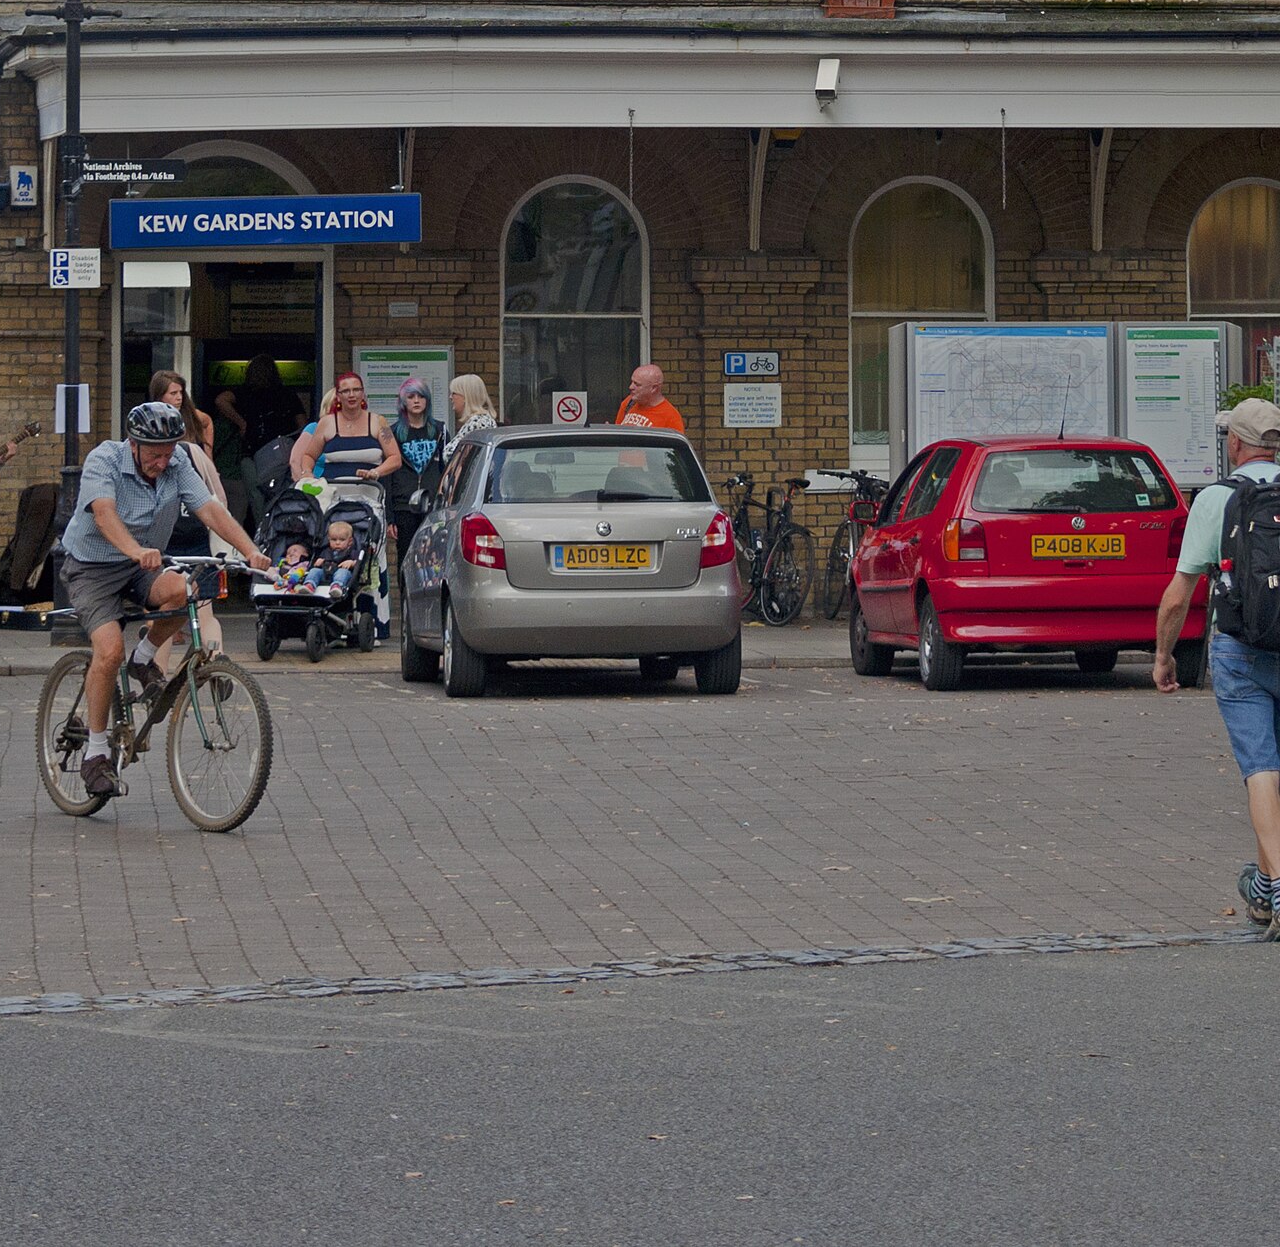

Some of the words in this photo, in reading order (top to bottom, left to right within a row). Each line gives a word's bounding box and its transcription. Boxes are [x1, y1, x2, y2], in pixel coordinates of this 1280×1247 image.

[83, 162, 112, 170] National
[113, 162, 143, 171] Archives
[95, 172, 130, 182] Footbridge
[139, 215, 187, 233] KEW
[193, 212, 295, 231] GARDENS
[300, 210, 393, 230] STATION
[56, 253, 68, 266] P
[730, 355, 744, 372] P
[1034, 538, 1082, 553] P408
[1087, 538, 1121, 553] KJB
[566, 548, 610, 564] AD09
[615, 548, 647, 563] LZC
